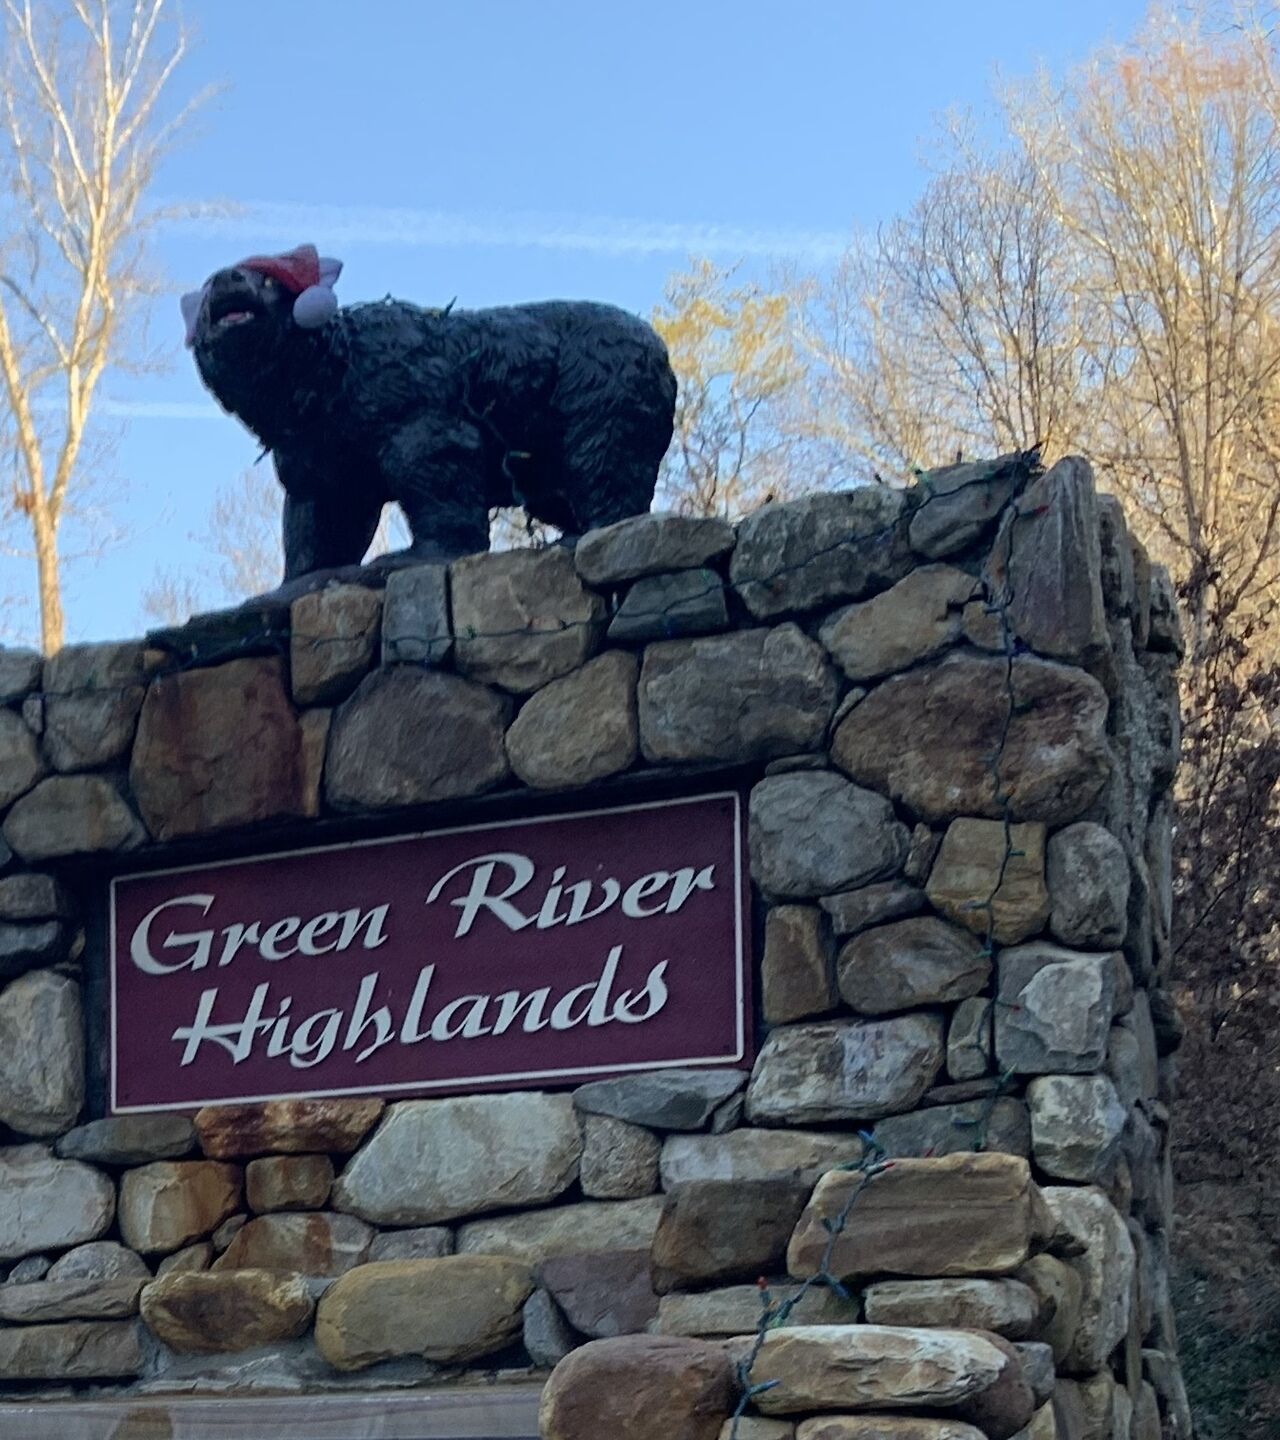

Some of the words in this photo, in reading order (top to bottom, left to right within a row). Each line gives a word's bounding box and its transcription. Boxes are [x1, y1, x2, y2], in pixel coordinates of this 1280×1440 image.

[130, 894, 389, 975] Green
[426, 852, 715, 939] River
[171, 945, 670, 1068] Highlands
